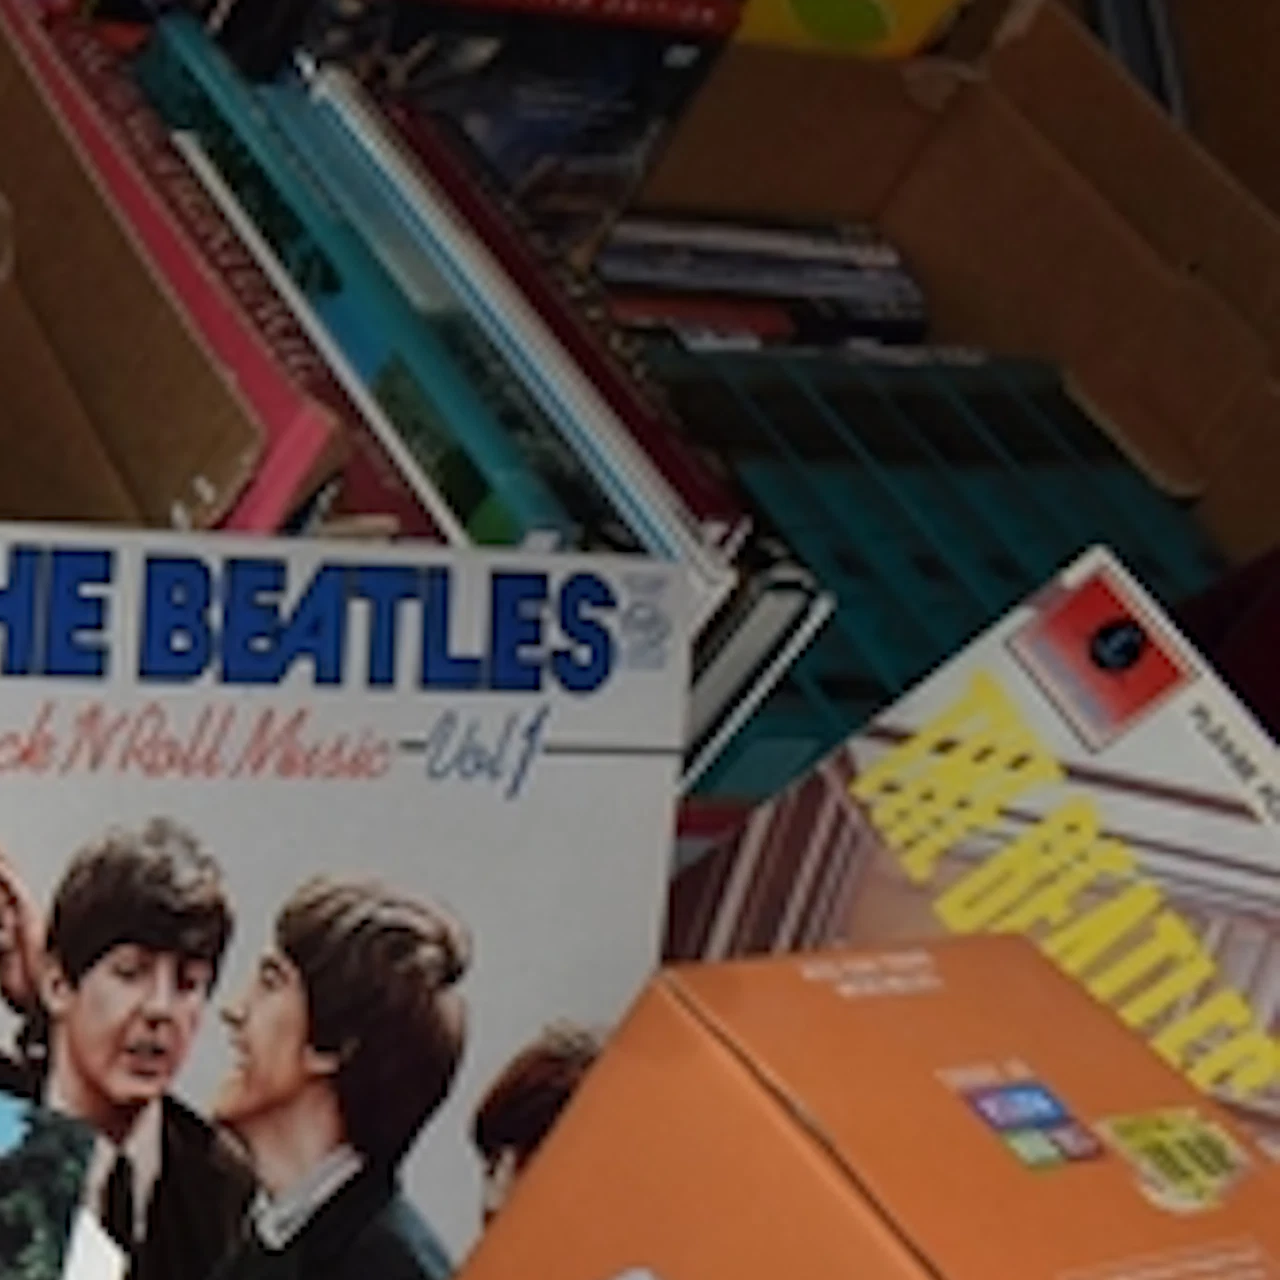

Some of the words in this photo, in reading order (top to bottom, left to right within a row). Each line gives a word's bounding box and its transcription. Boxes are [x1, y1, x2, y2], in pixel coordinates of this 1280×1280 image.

[136, 551, 622, 694] BEATLES
[117, 700, 238, 780] Roll
[229, 705, 391, 782] Music
